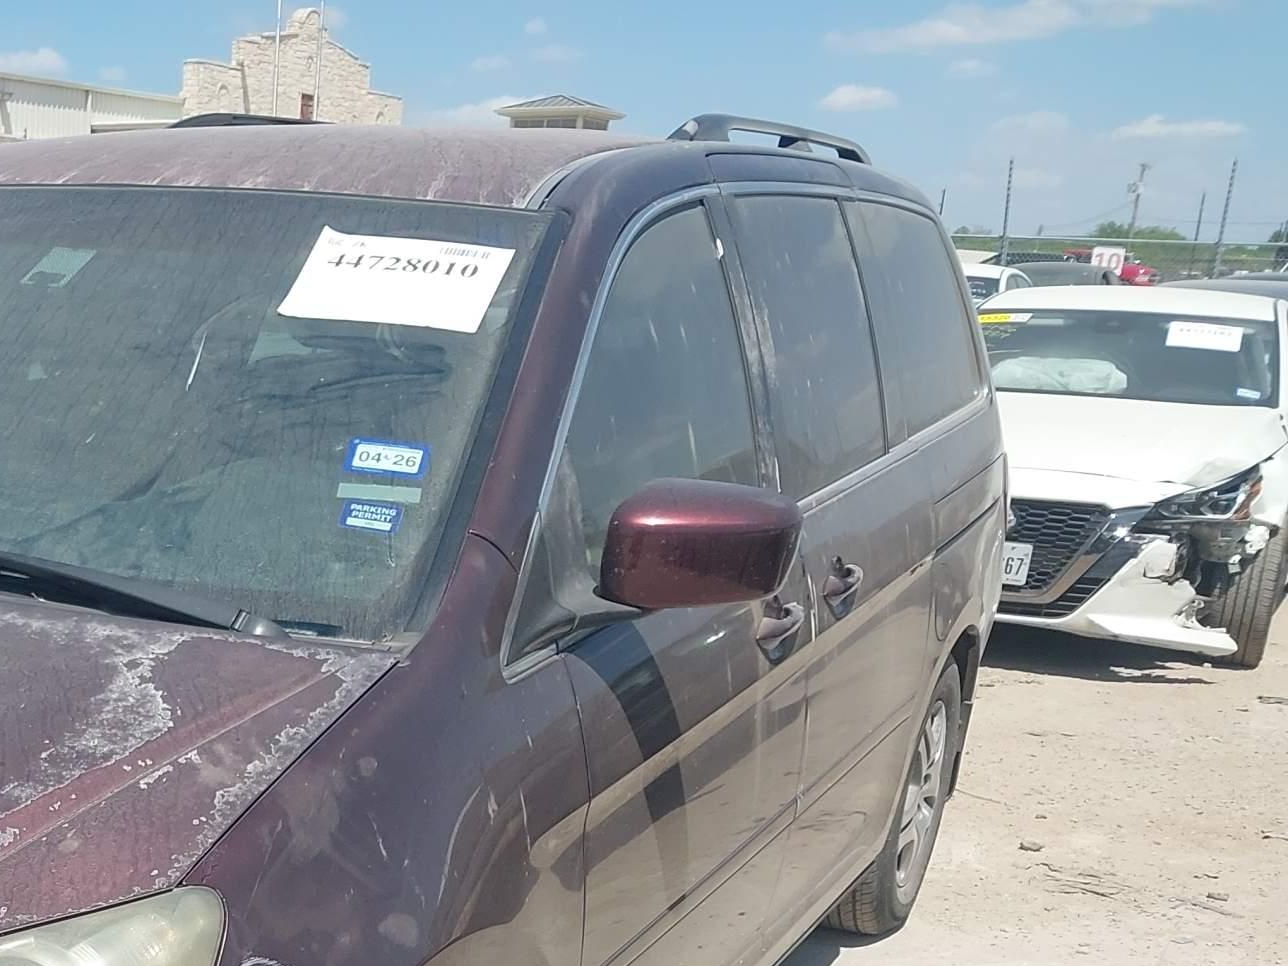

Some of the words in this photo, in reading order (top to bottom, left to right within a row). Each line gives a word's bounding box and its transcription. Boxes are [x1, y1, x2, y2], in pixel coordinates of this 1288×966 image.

[327, 253, 479, 278] 44728010
[1095, 252, 1121, 270] 10
[350, 503, 398, 516] PARKING
[351, 510, 393, 523] PERMIT
[1002, 556, 1025, 576] 67
